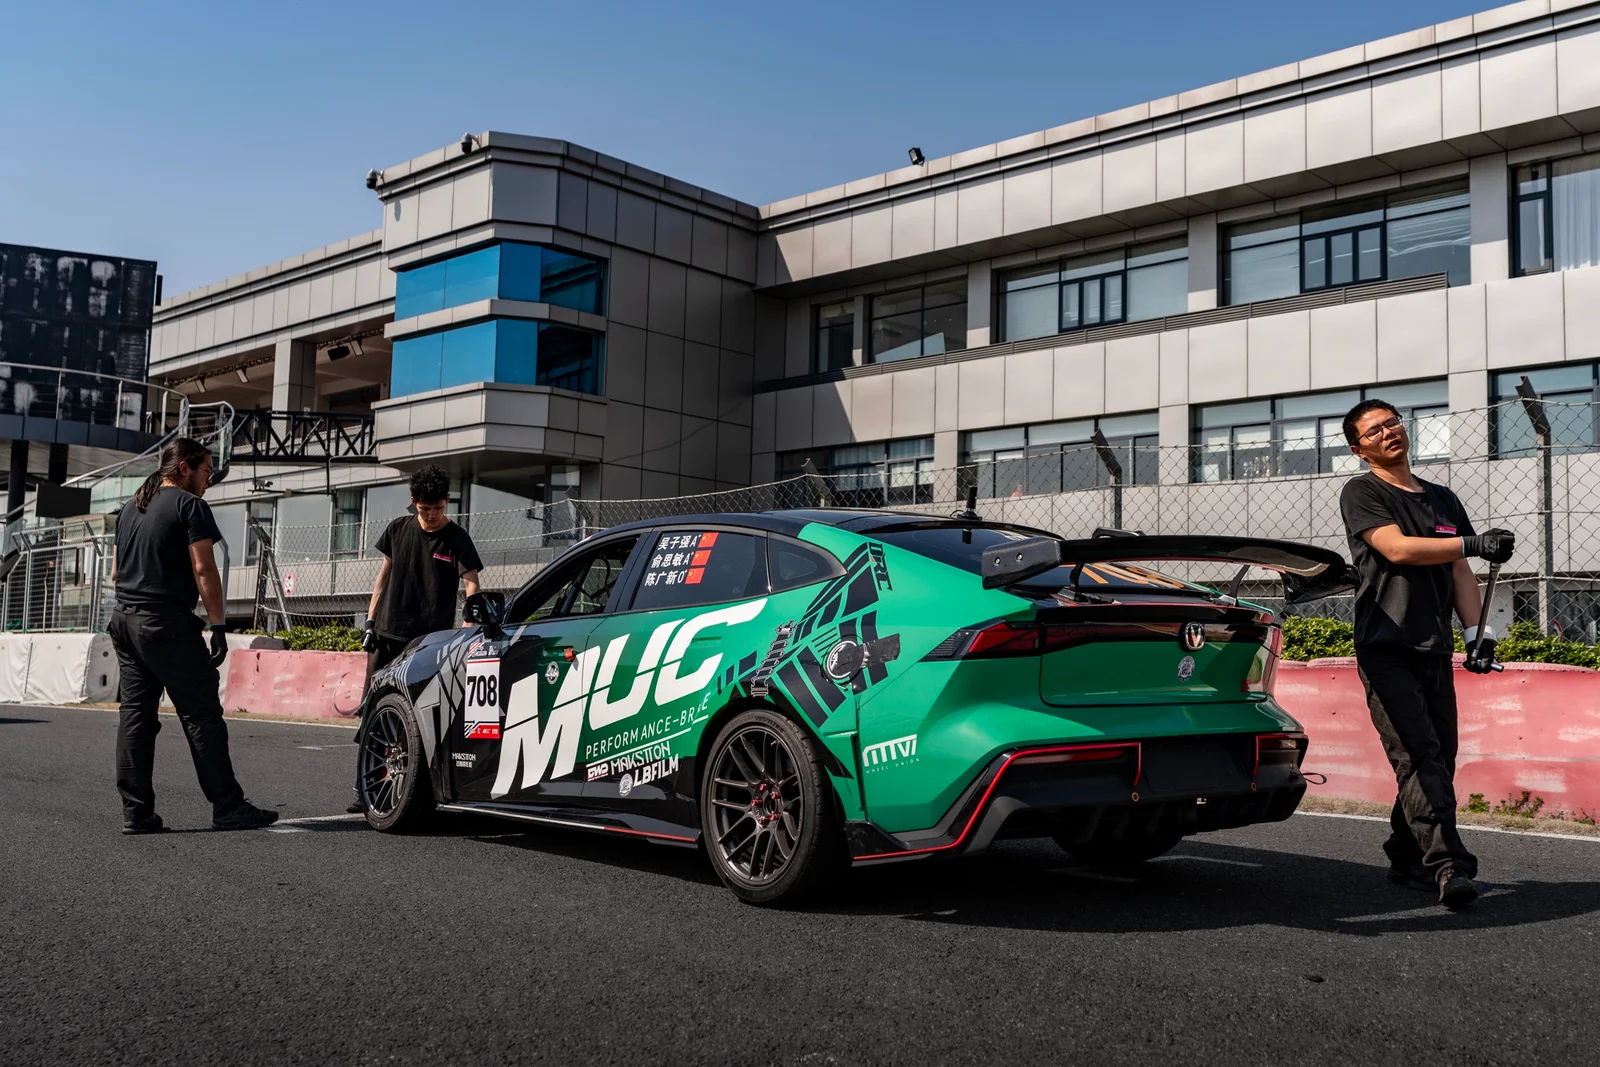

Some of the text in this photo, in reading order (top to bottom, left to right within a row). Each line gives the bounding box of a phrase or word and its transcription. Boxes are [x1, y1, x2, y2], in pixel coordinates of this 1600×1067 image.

[467, 674, 498, 708] 708
[490, 598, 768, 800] MUC
[632, 753, 679, 788] LBFILM
